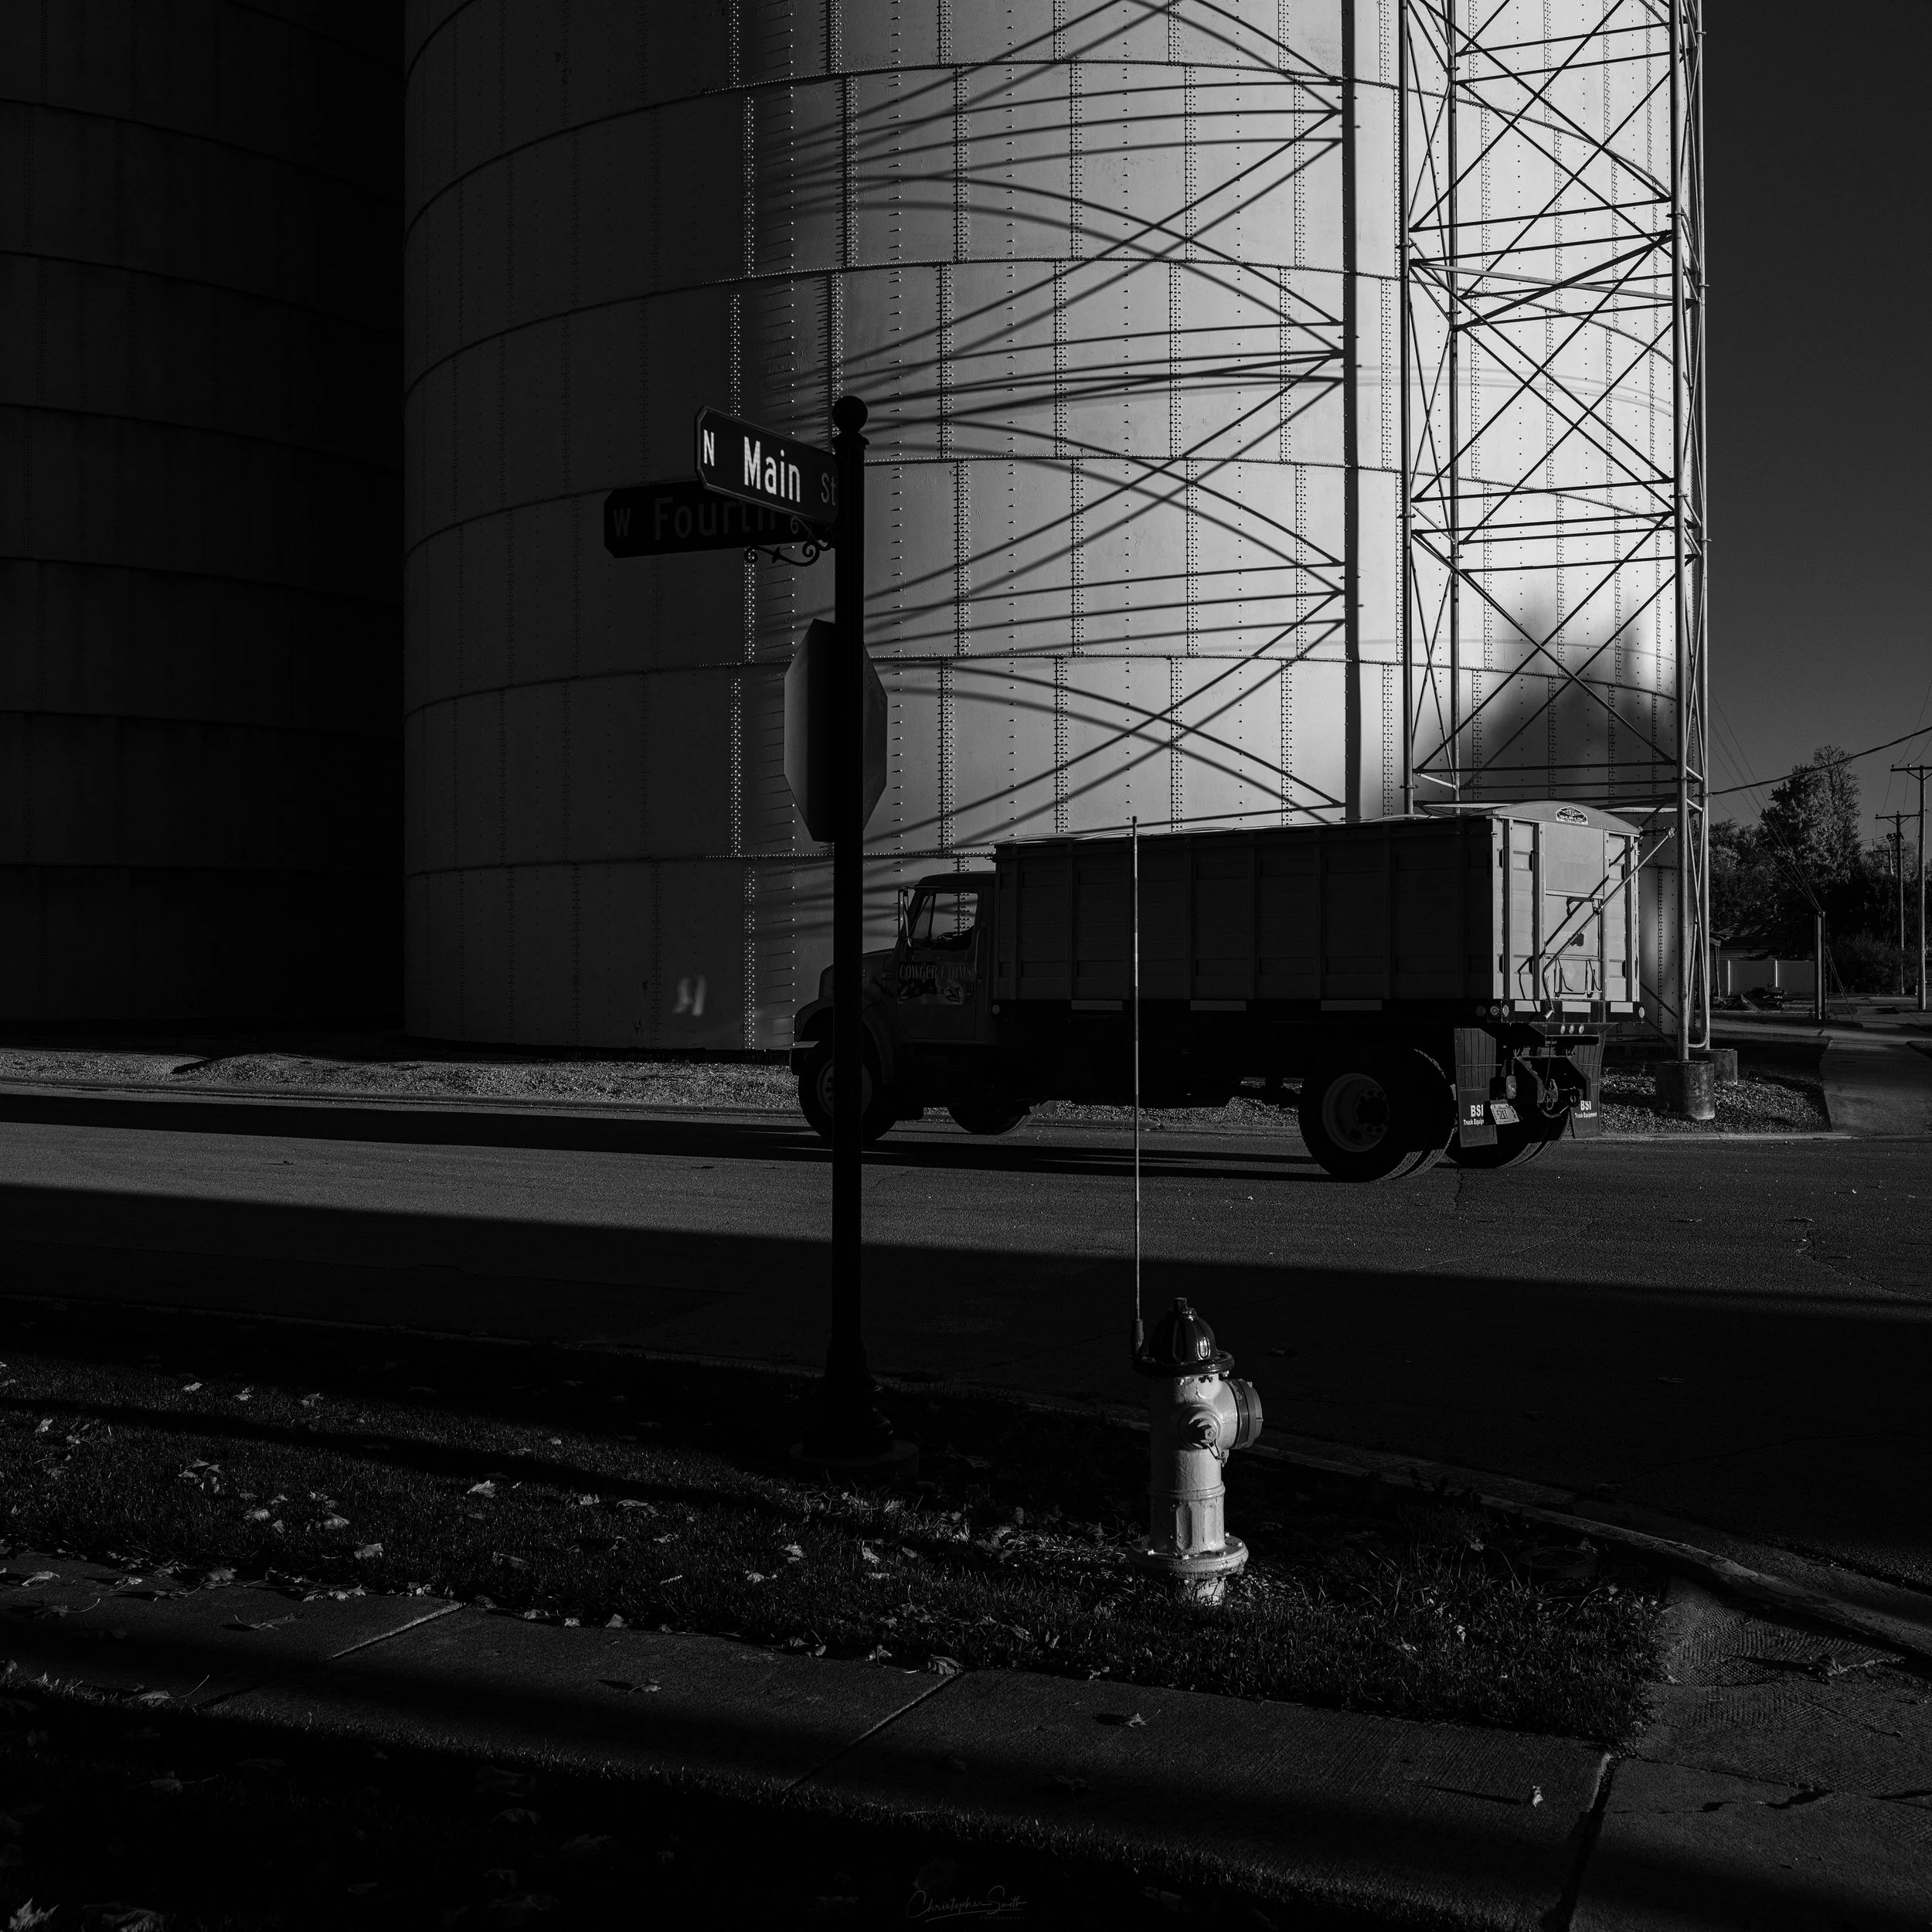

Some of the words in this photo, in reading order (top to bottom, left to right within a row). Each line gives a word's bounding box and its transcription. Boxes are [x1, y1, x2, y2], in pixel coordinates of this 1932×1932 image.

[702, 429, 716, 467] N
[743, 436, 801, 502] Main
[820, 471, 837, 506] St
[612, 506, 631, 538] W
[899, 964, 937, 979] COWGER
[940, 965, 972, 979] FARMS
[1471, 1104, 1484, 1117] BSI
[1580, 1100, 1591, 1111] BSI
